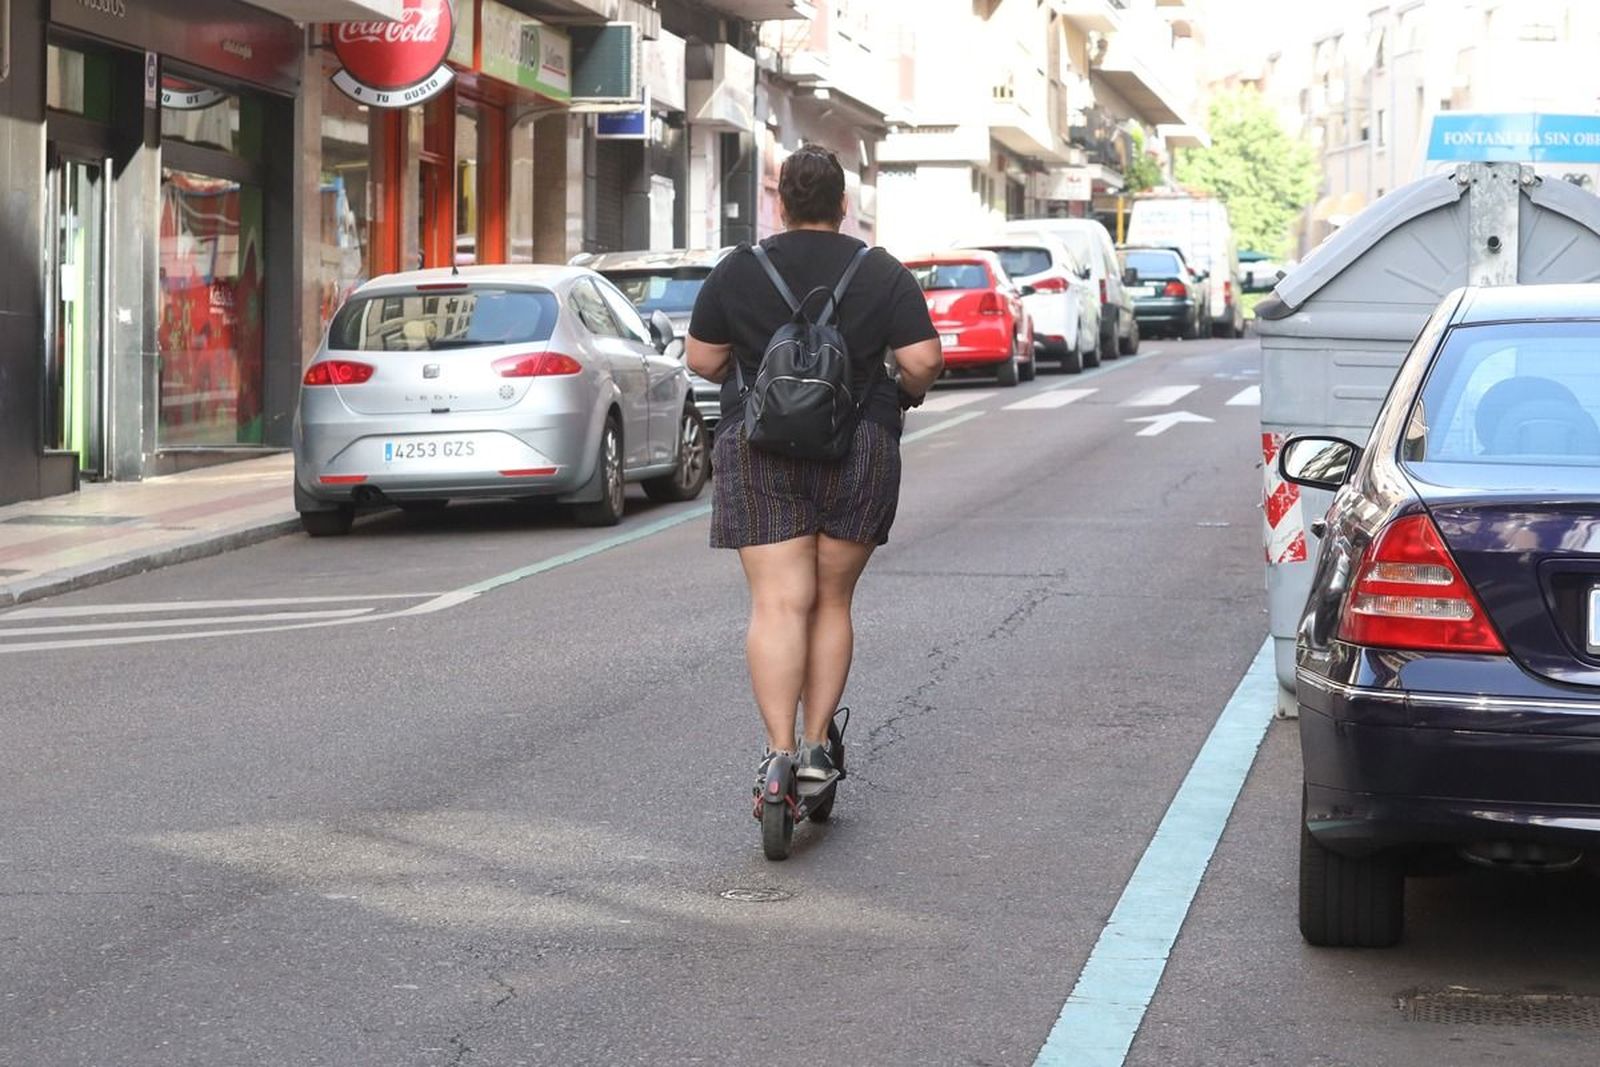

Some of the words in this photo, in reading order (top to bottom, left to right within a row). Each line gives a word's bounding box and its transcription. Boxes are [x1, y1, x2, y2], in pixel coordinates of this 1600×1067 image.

[384, 7, 439, 42] Cola
[354, 86, 363, 96] A
[376, 94, 390, 103] TU
[404, 79, 439, 101] GUSTO
[1544, 131, 1570, 145] SIN
[395, 442, 437, 459] 4253
[442, 440, 475, 457] GZS
